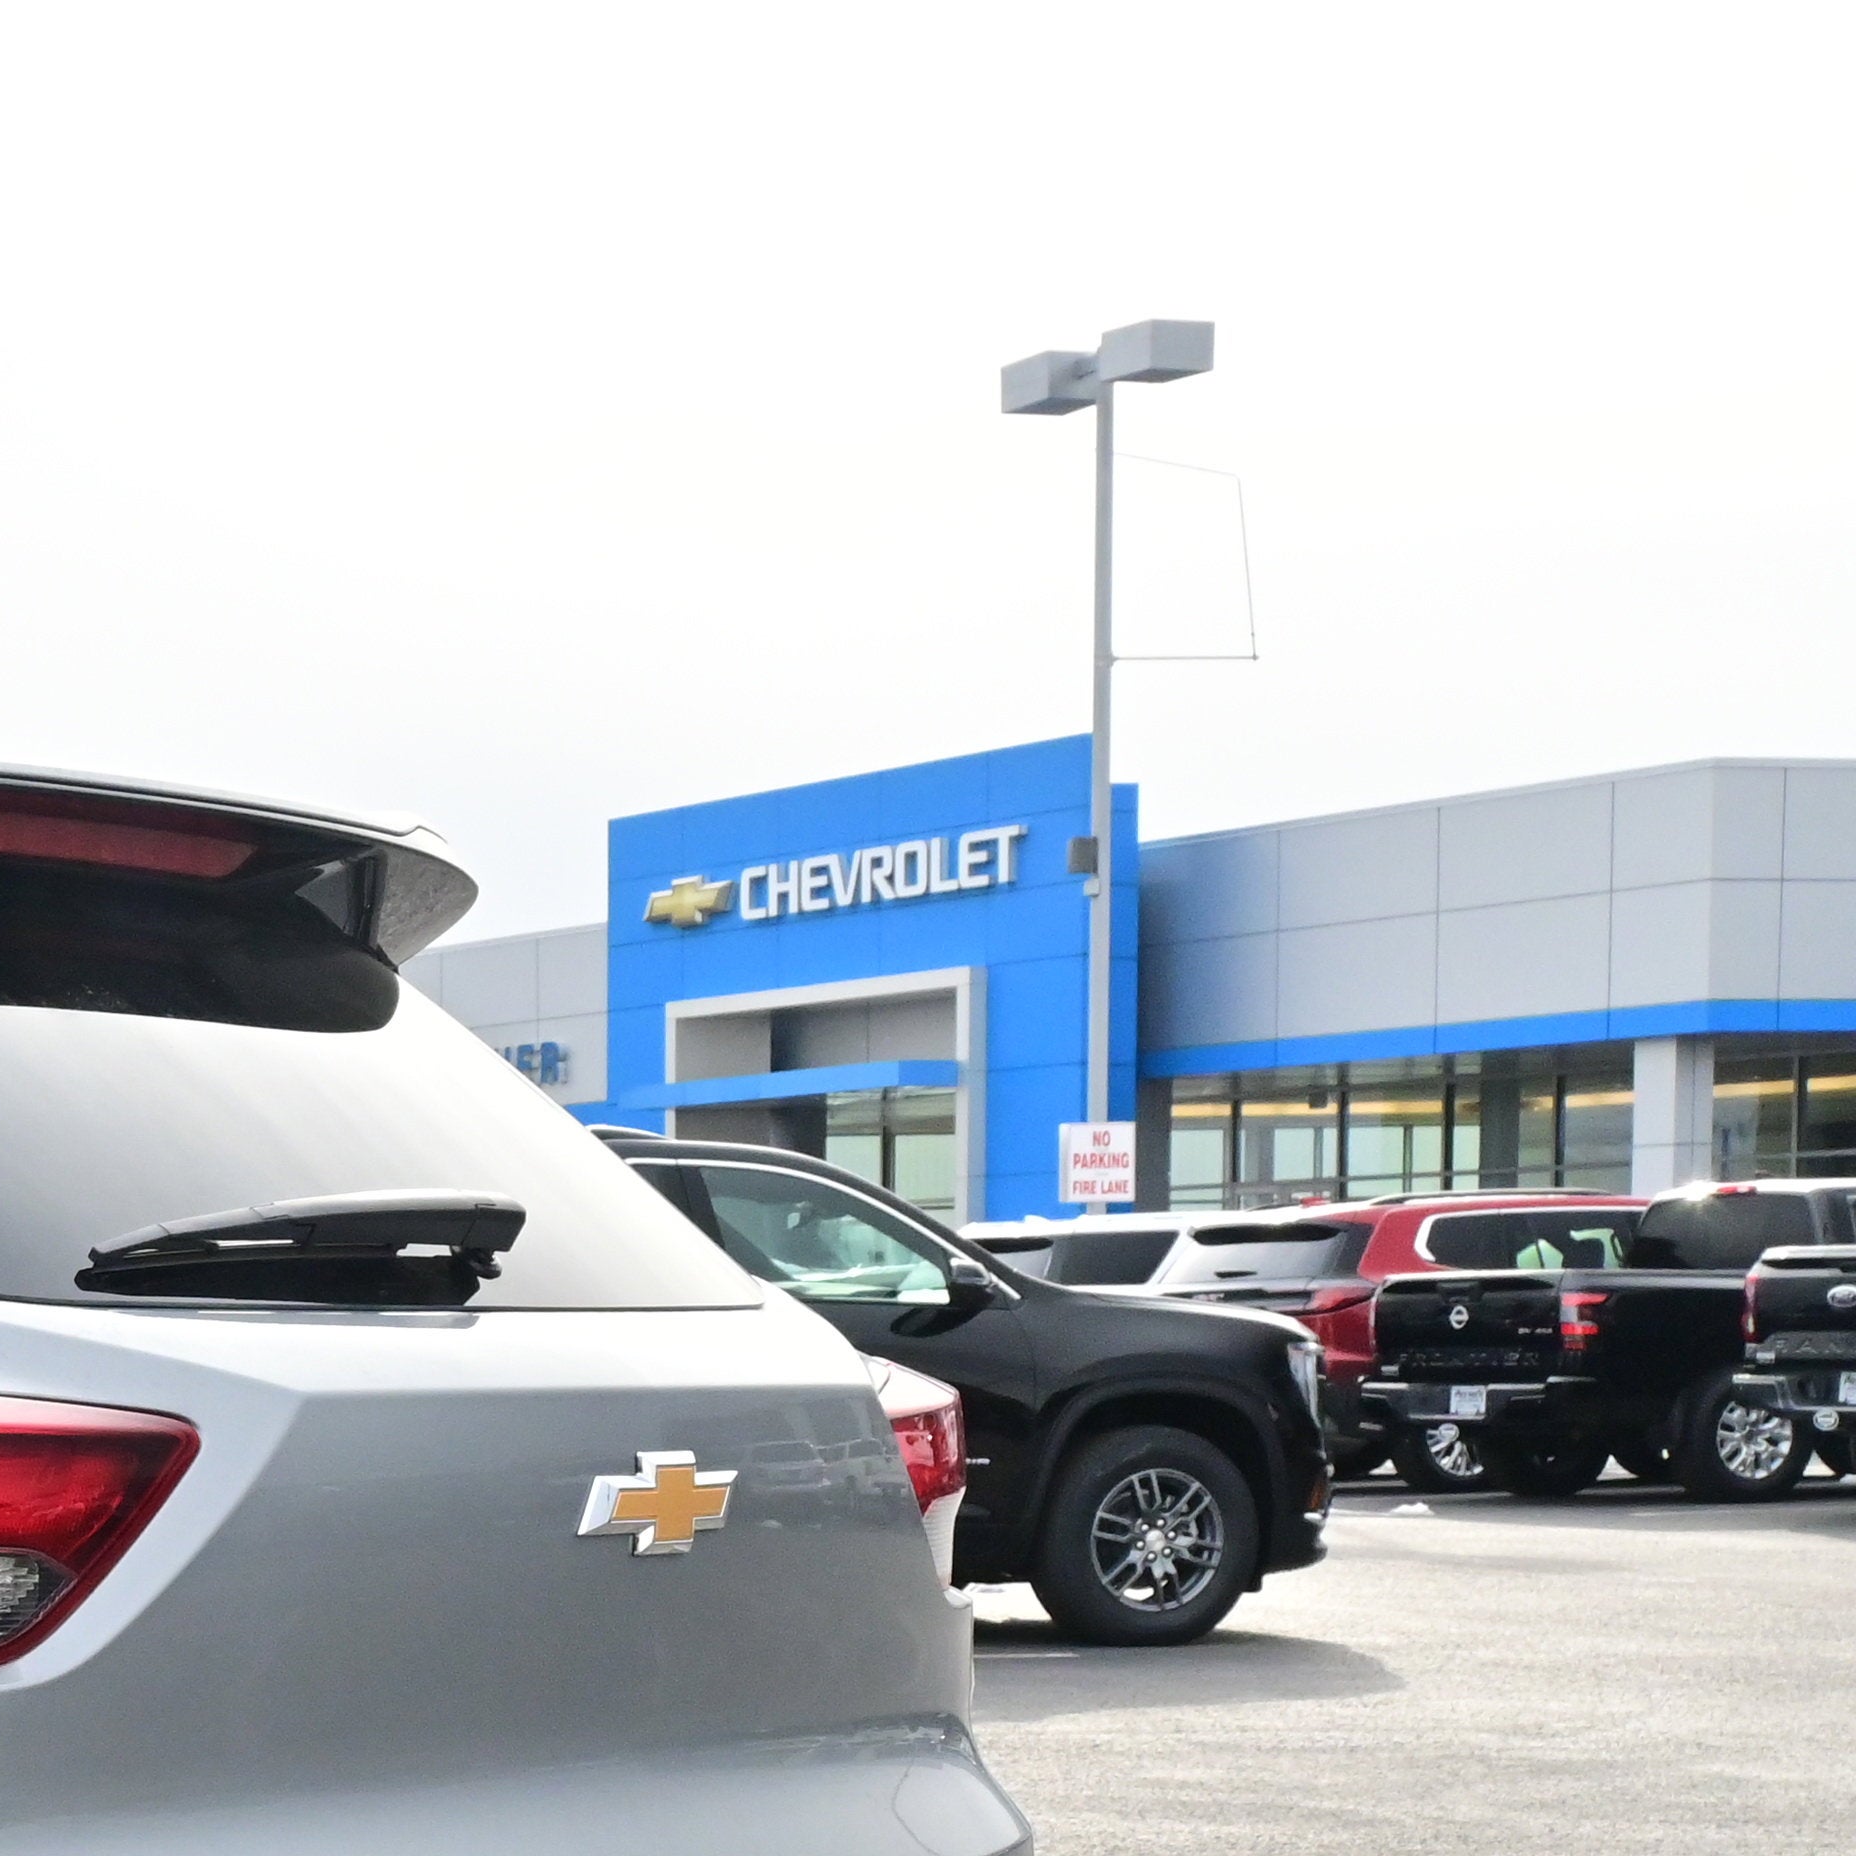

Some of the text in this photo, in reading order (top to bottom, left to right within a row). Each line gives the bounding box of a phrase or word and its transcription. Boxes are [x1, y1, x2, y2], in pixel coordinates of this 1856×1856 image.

[739, 824, 1029, 921] CHEVROLET
[1092, 1130, 1111, 1147] NO
[1073, 1152, 1130, 1169] PARKING
[1073, 1180, 1129, 1194] FIRE LANE
